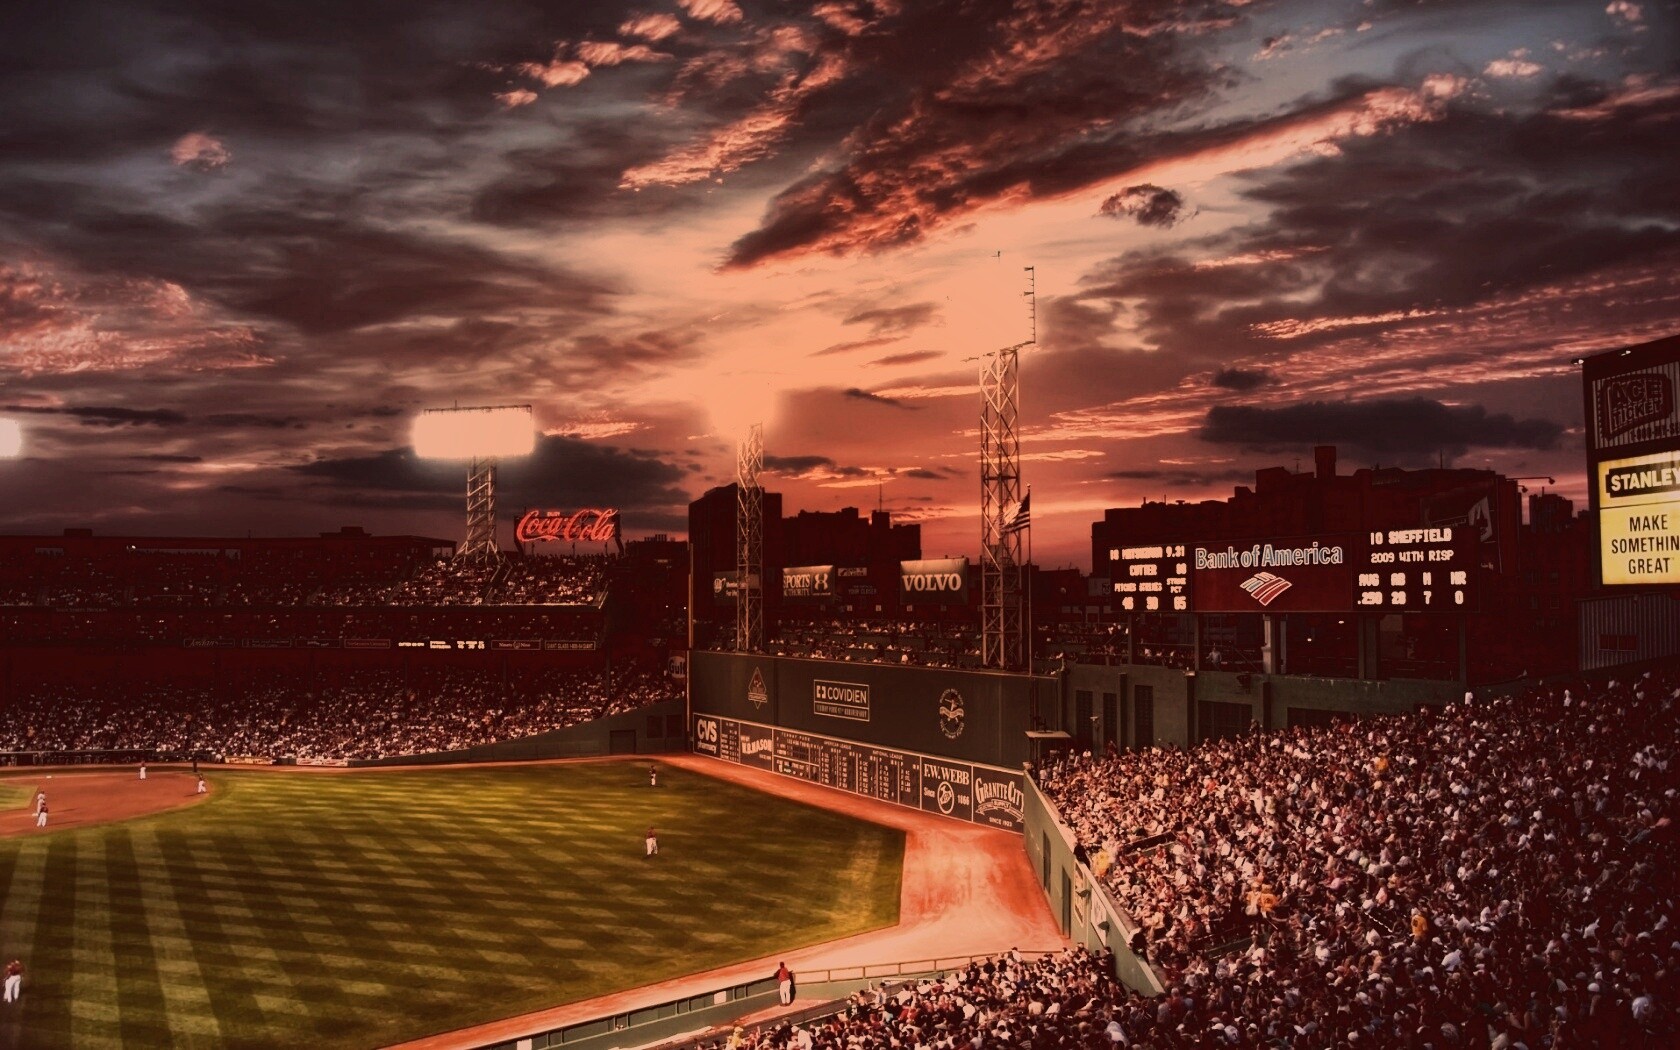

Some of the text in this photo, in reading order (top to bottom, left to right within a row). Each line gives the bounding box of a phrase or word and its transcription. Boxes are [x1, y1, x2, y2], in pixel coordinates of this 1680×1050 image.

[1612, 378, 1663, 405] ACE
[1612, 398, 1662, 431] TICKET
[1610, 467, 1680, 492] STANLEY
[516, 508, 619, 542] Coca-Cola
[1629, 514, 1668, 532] MAKE
[1370, 527, 1452, 545] 10 SHEFFIELD
[1611, 535, 1680, 554] SOMETHIN
[1195, 541, 1343, 569] Bank of America
[1370, 549, 1454, 563] 2009 WITH RISP
[1129, 564, 1157, 576] CUTTER
[1628, 557, 1670, 574] GREAT
[783, 574, 811, 589] SPORTS
[901, 573, 962, 592] VOLVO
[1358, 573, 1380, 586] AVG
[1423, 591, 1432, 604] 7
[1454, 590, 1464, 605] 0
[827, 686, 867, 704] COVIDIEN
[697, 719, 717, 743] CVS
[940, 766, 970, 786] WEBB
[975, 777, 1008, 804] GRANITE
[989, 816, 1002, 825] SINCE
